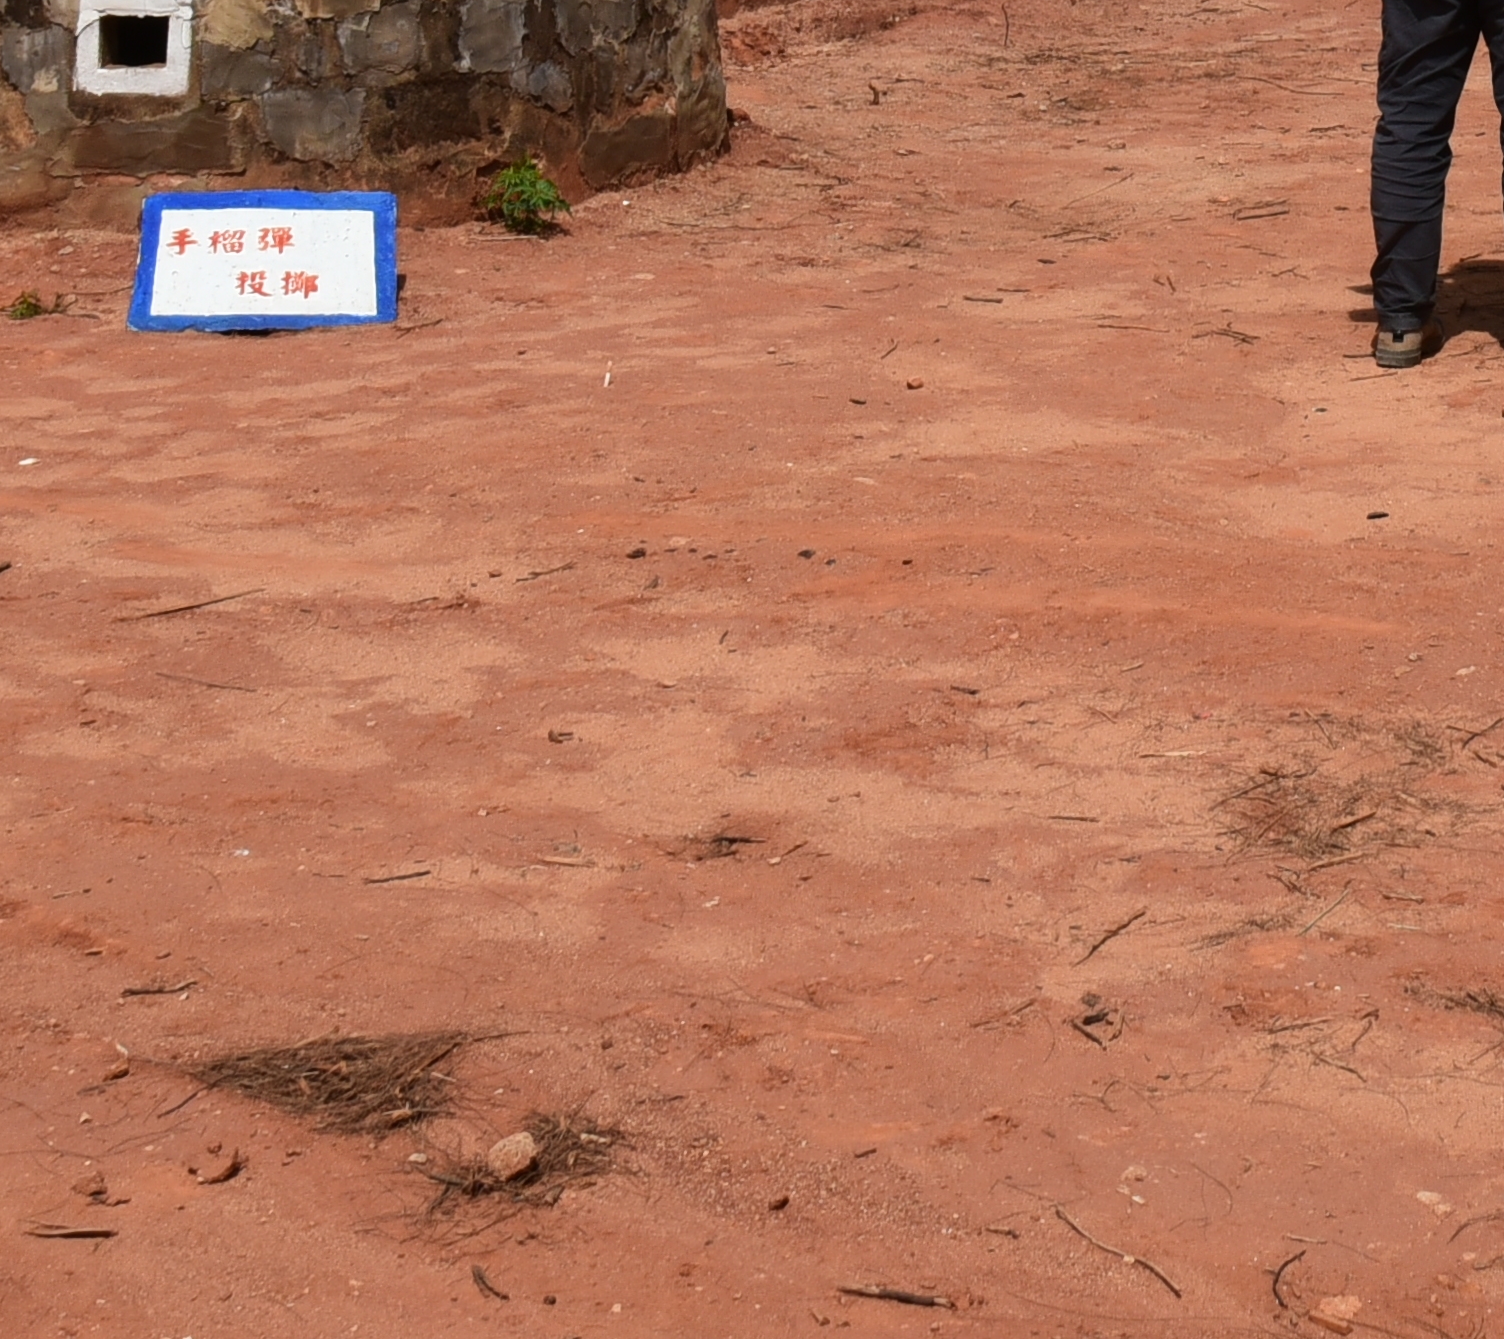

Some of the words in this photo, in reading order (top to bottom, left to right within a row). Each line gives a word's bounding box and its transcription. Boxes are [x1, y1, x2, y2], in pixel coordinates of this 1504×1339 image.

[165, 226, 296, 256] 手榴彈
[235, 270, 320, 300] 投擲
